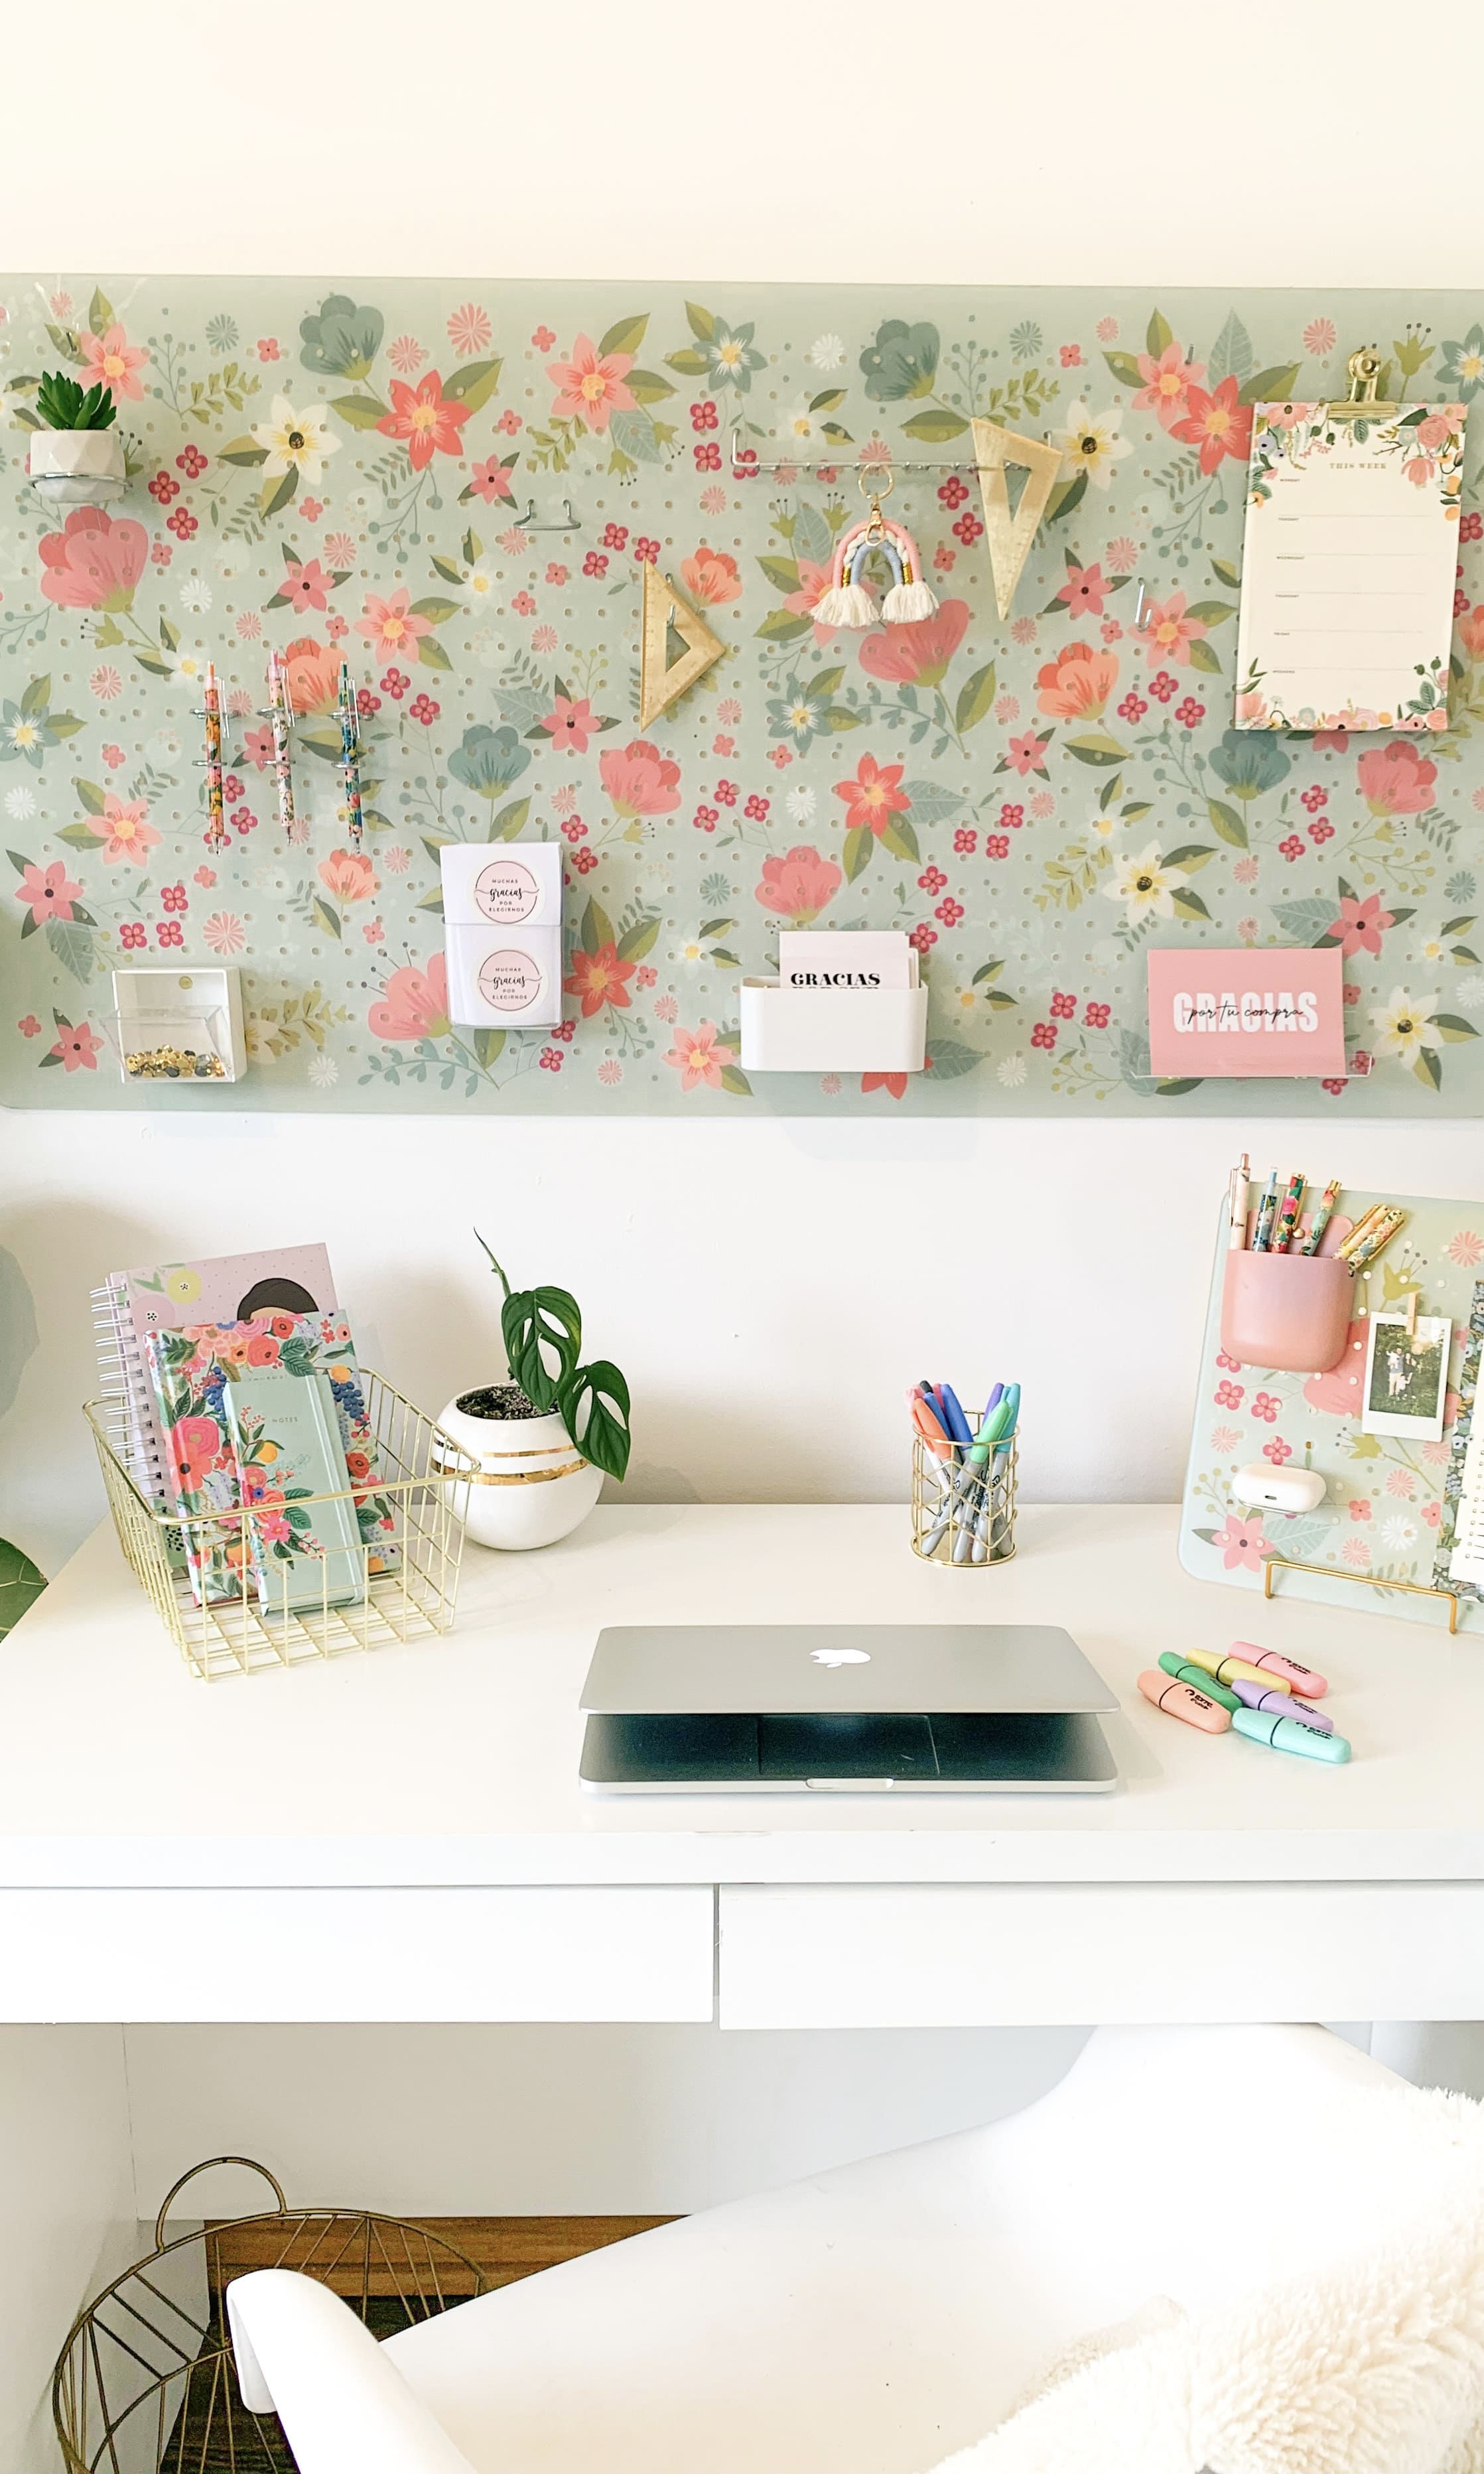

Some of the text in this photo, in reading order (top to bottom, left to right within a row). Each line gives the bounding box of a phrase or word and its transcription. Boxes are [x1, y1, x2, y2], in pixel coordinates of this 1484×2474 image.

[1329, 461, 1355, 470] THIS
[790, 973, 881, 986] GRACIAS
[1172, 991, 1319, 1033] GRACIAS
[1187, 1000, 1304, 1024] por tu compra
